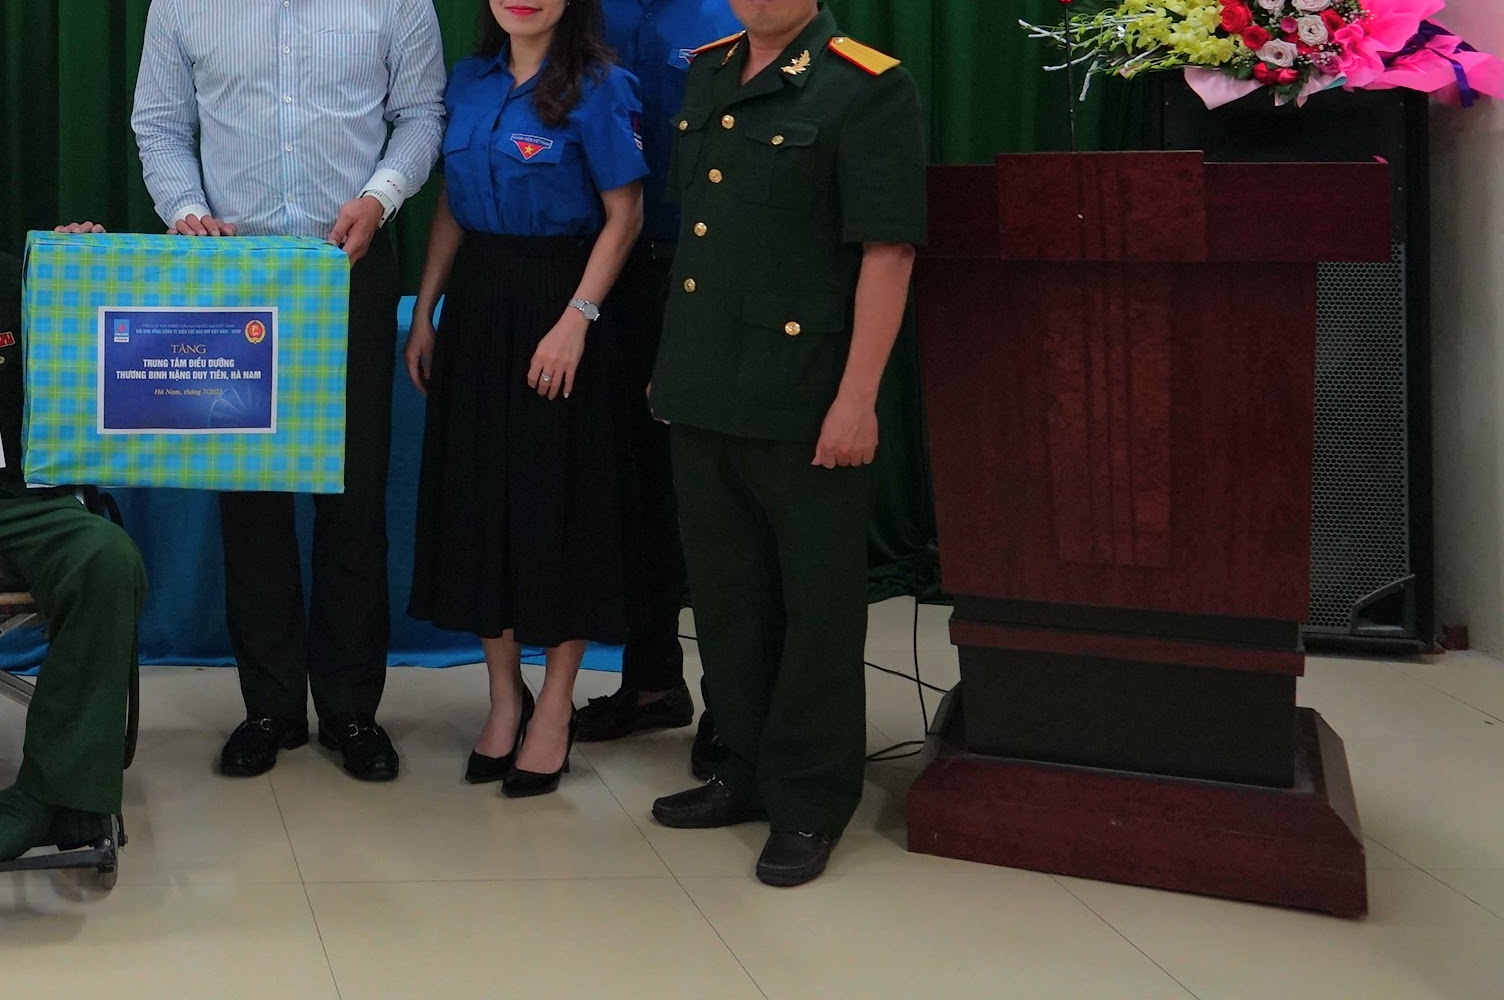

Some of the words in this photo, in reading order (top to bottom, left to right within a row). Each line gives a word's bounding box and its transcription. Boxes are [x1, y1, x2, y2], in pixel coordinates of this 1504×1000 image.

[143, 358, 168, 368] TRUNG
[170, 356, 187, 368] TÂM
[116, 370, 146, 380] THƯƠNG
[148, 370, 167, 380] BINH
[192, 370, 208, 380] DUY
[231, 368, 241, 380] HÀ
[243, 370, 261, 380] NAM
